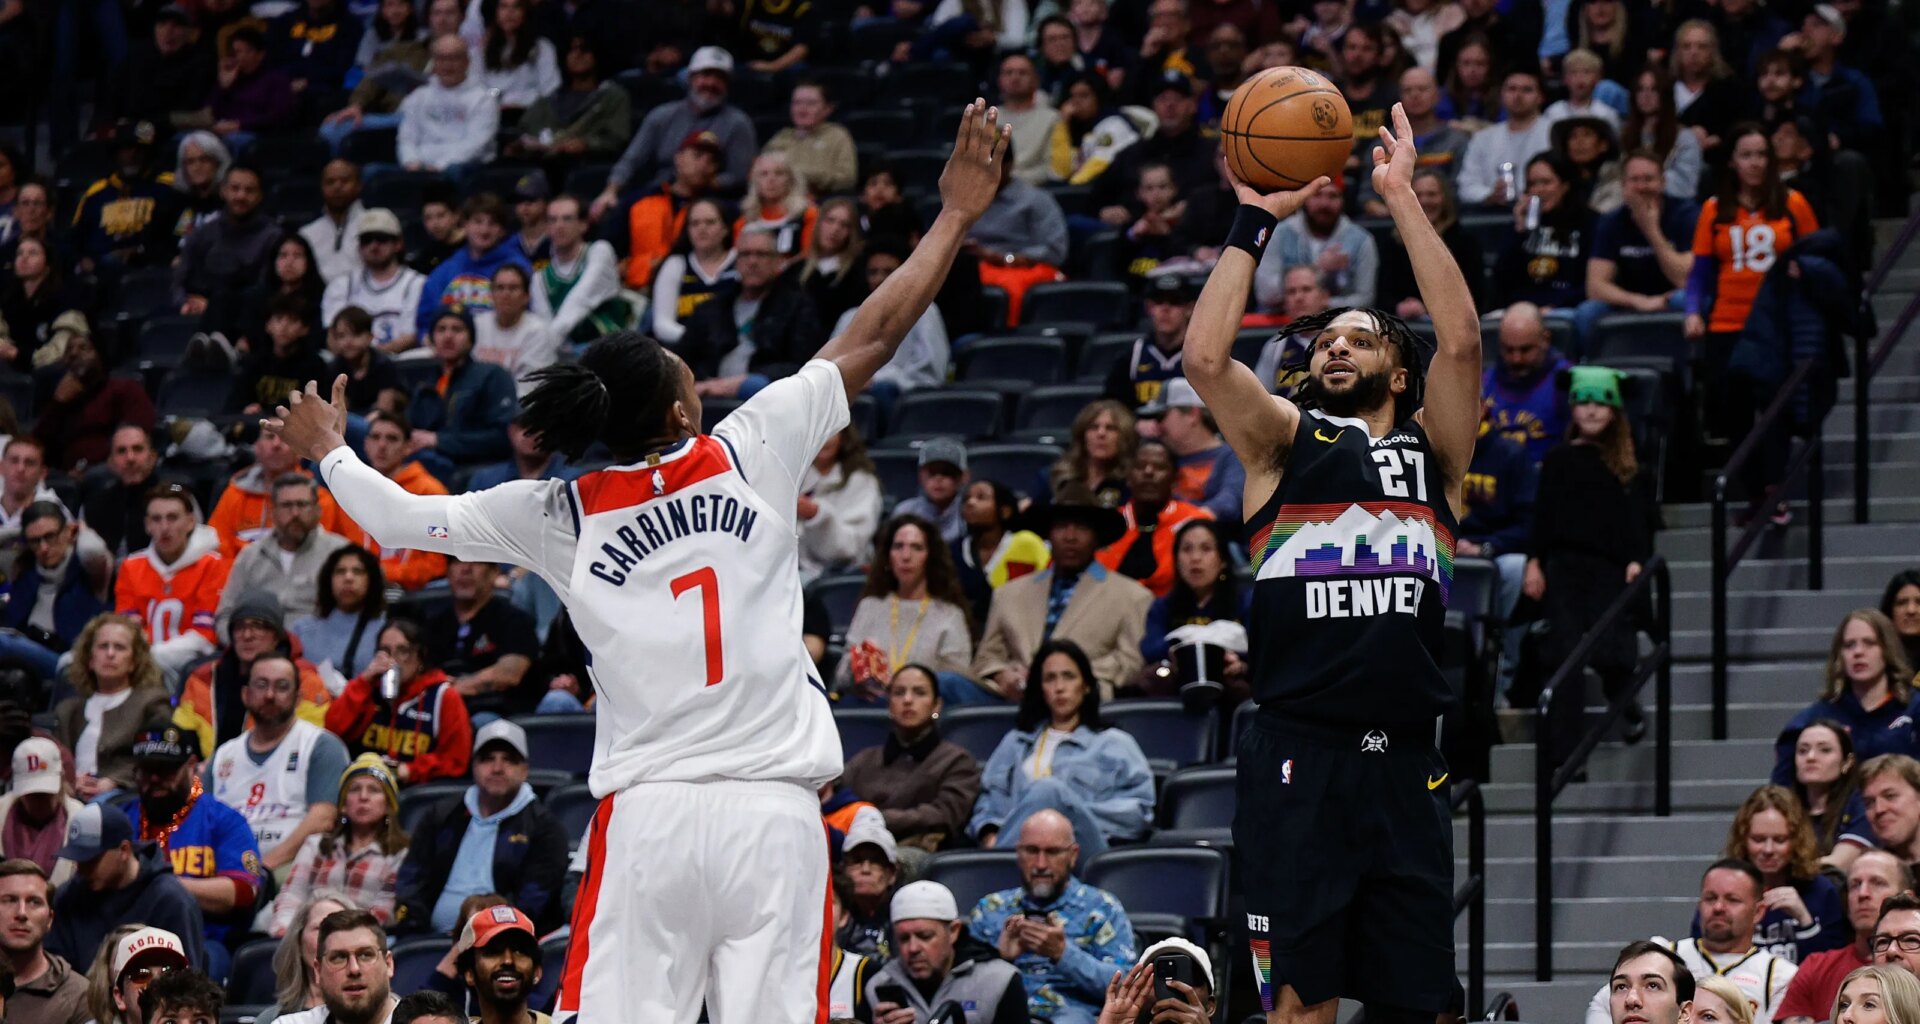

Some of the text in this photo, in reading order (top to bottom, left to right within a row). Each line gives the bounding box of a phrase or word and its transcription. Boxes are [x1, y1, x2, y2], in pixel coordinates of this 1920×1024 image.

[1728, 223, 1776, 273] 18
[1375, 433, 1420, 449] ibotta
[1370, 448, 1428, 502] 27
[589, 494, 758, 587] CARRINGTON
[1302, 576, 1426, 620] DENVER
[669, 566, 723, 687] 7
